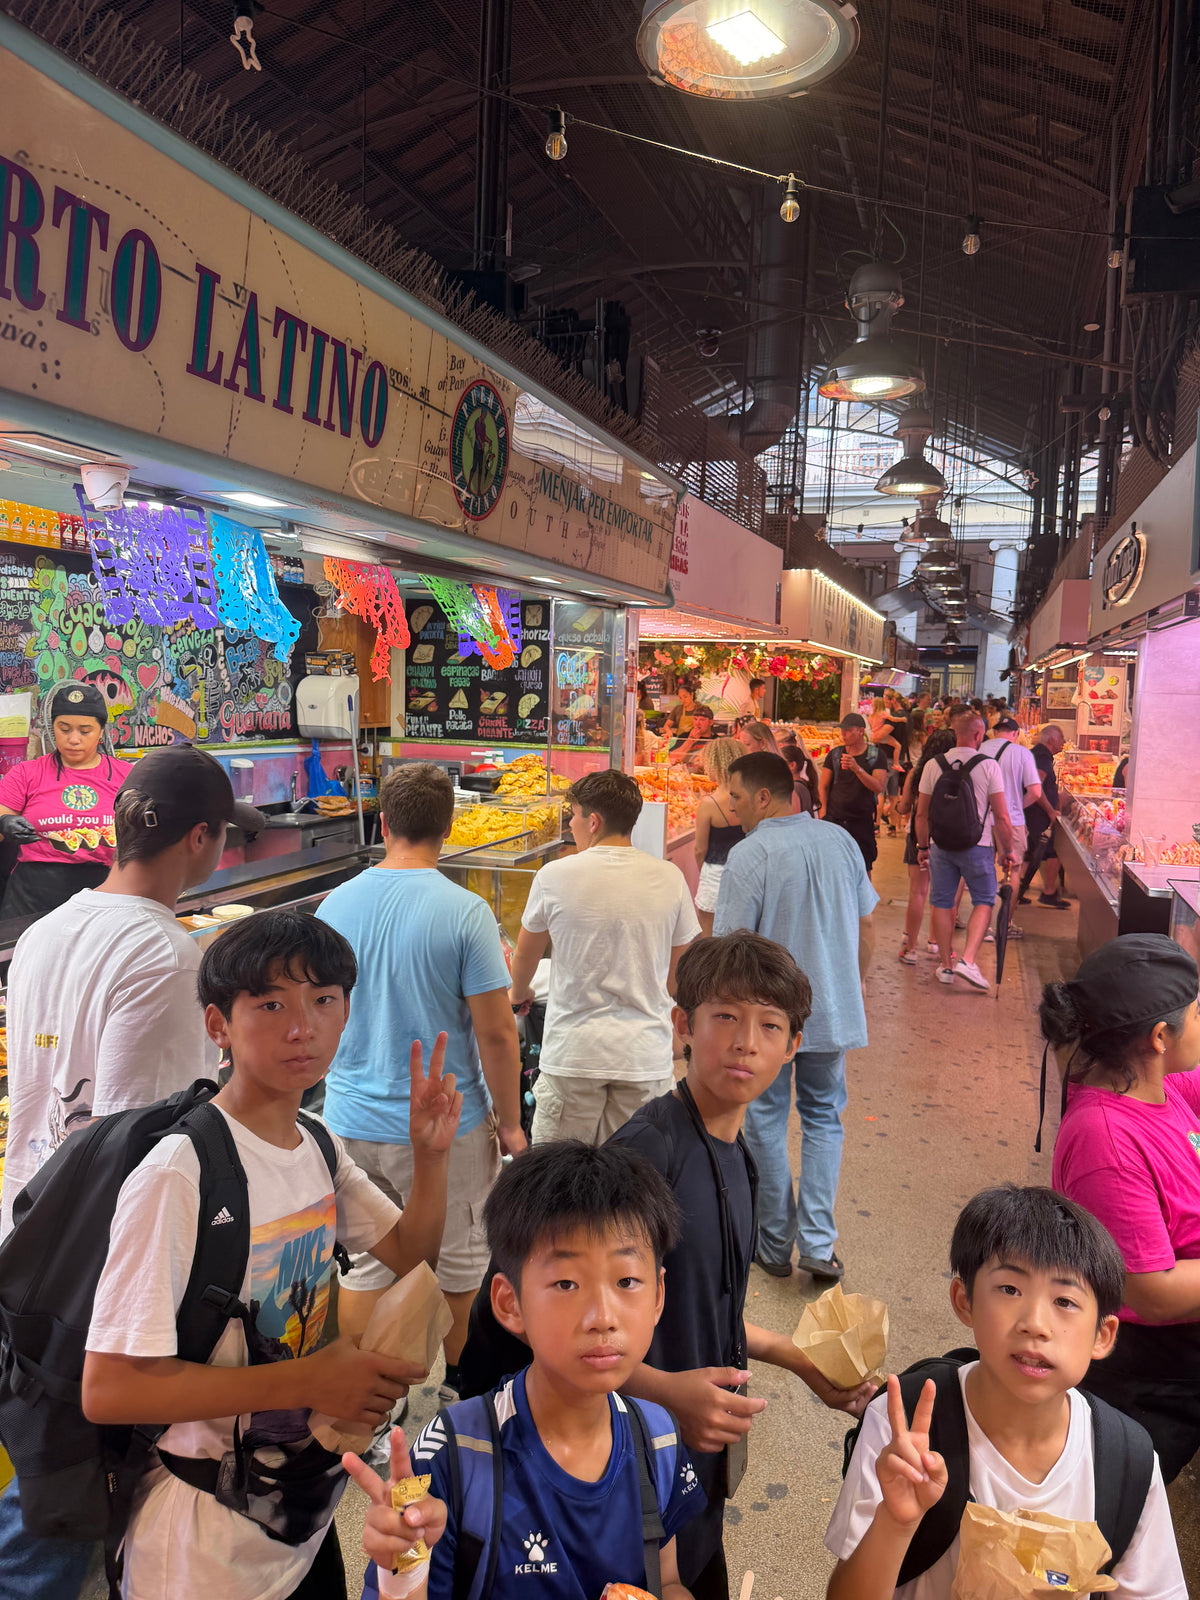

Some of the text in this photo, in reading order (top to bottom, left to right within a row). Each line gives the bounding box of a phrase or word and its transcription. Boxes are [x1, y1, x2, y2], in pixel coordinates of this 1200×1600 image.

[0, 154, 389, 448] RTO LATINO
[450, 355, 466, 372] Bay
[461, 386, 506, 439] PUERTO
[538, 467, 586, 514] MENJAR
[586, 490, 606, 523] PER
[606, 502, 654, 545] EMPORTAR
[59, 601, 153, 661] Guacole
[215, 628, 231, 694] TACOS
[225, 637, 261, 675] BEER
[134, 724, 176, 747] NACHOS
[516, 719, 546, 732] PIZZA
[38, 813, 115, 827] would you lik
[211, 1216, 235, 1226] adidas
[276, 1223, 326, 1296] NIKE
[681, 1476, 699, 1496] KEL
[514, 1562, 558, 1575] KELME
